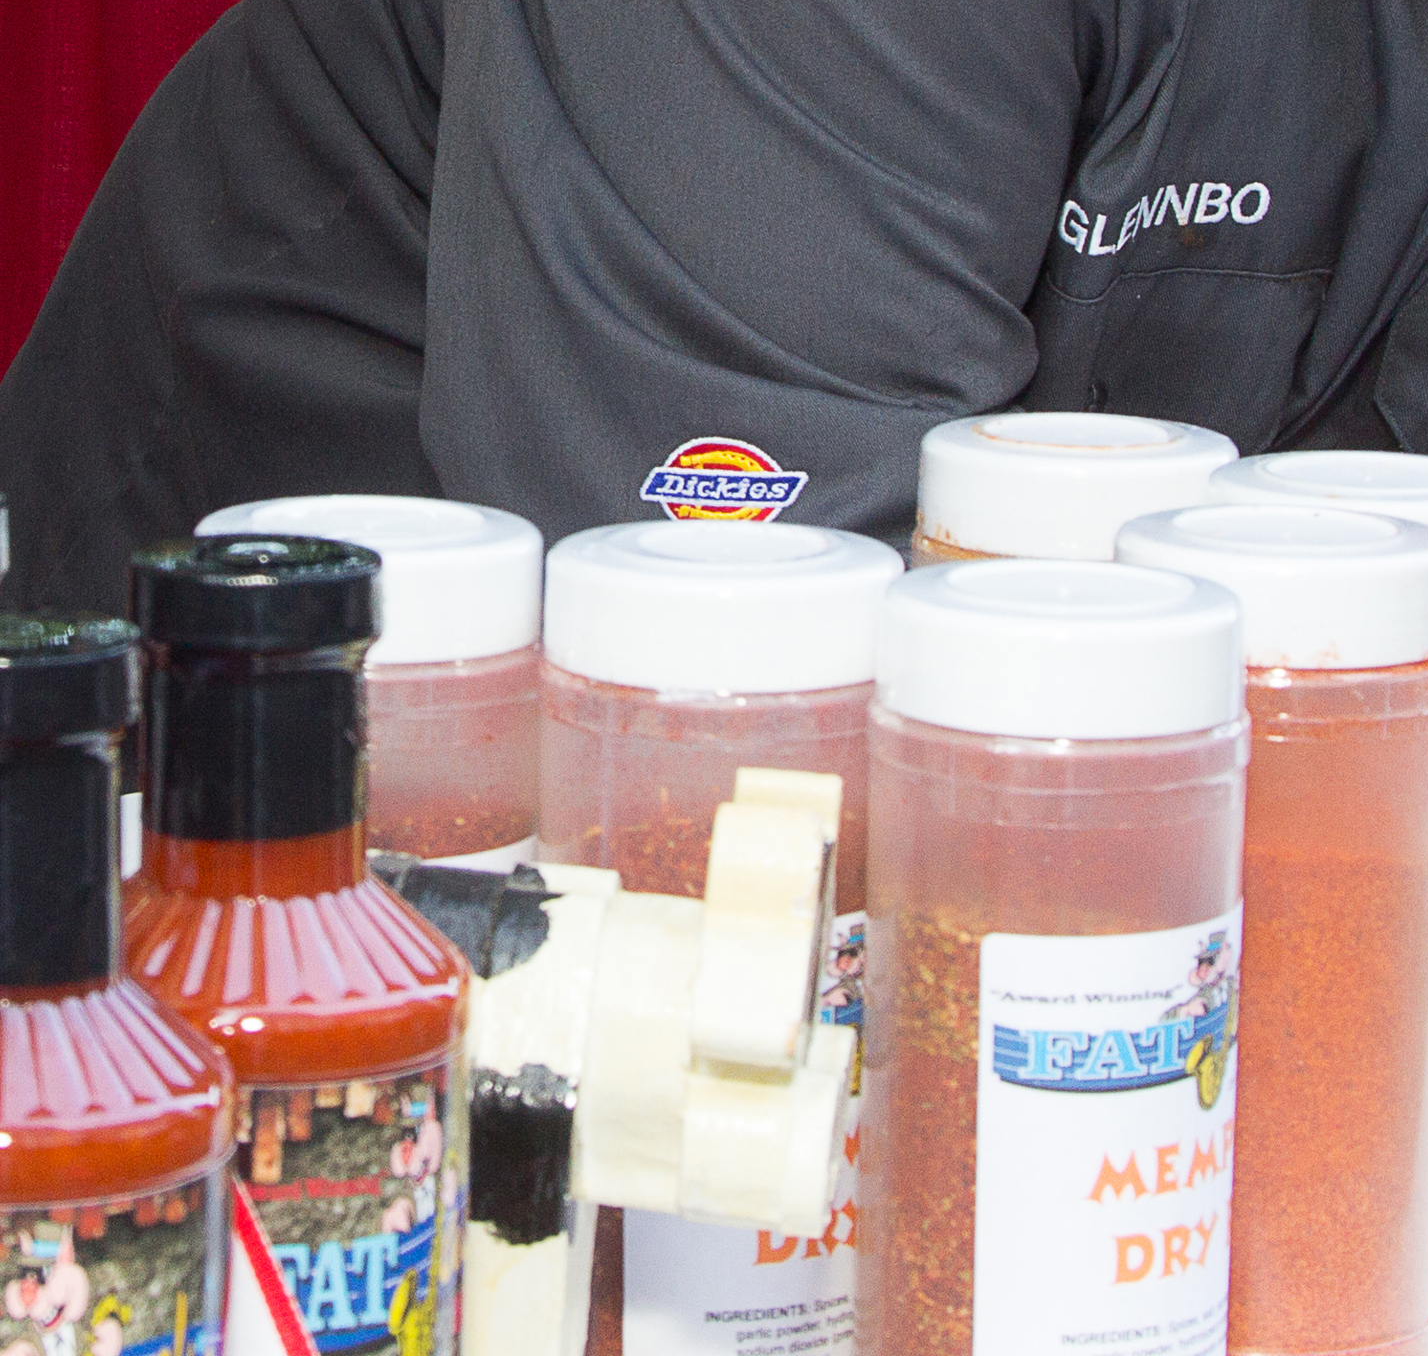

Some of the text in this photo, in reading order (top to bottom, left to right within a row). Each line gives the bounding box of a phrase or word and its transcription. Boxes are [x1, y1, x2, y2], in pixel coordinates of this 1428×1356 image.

[1058, 181, 1271, 256] GLENNBO
[656, 474, 790, 500] Dickies
[1017, 1016, 1196, 1082] FAT
[1112, 1210, 1219, 1286] DRY
